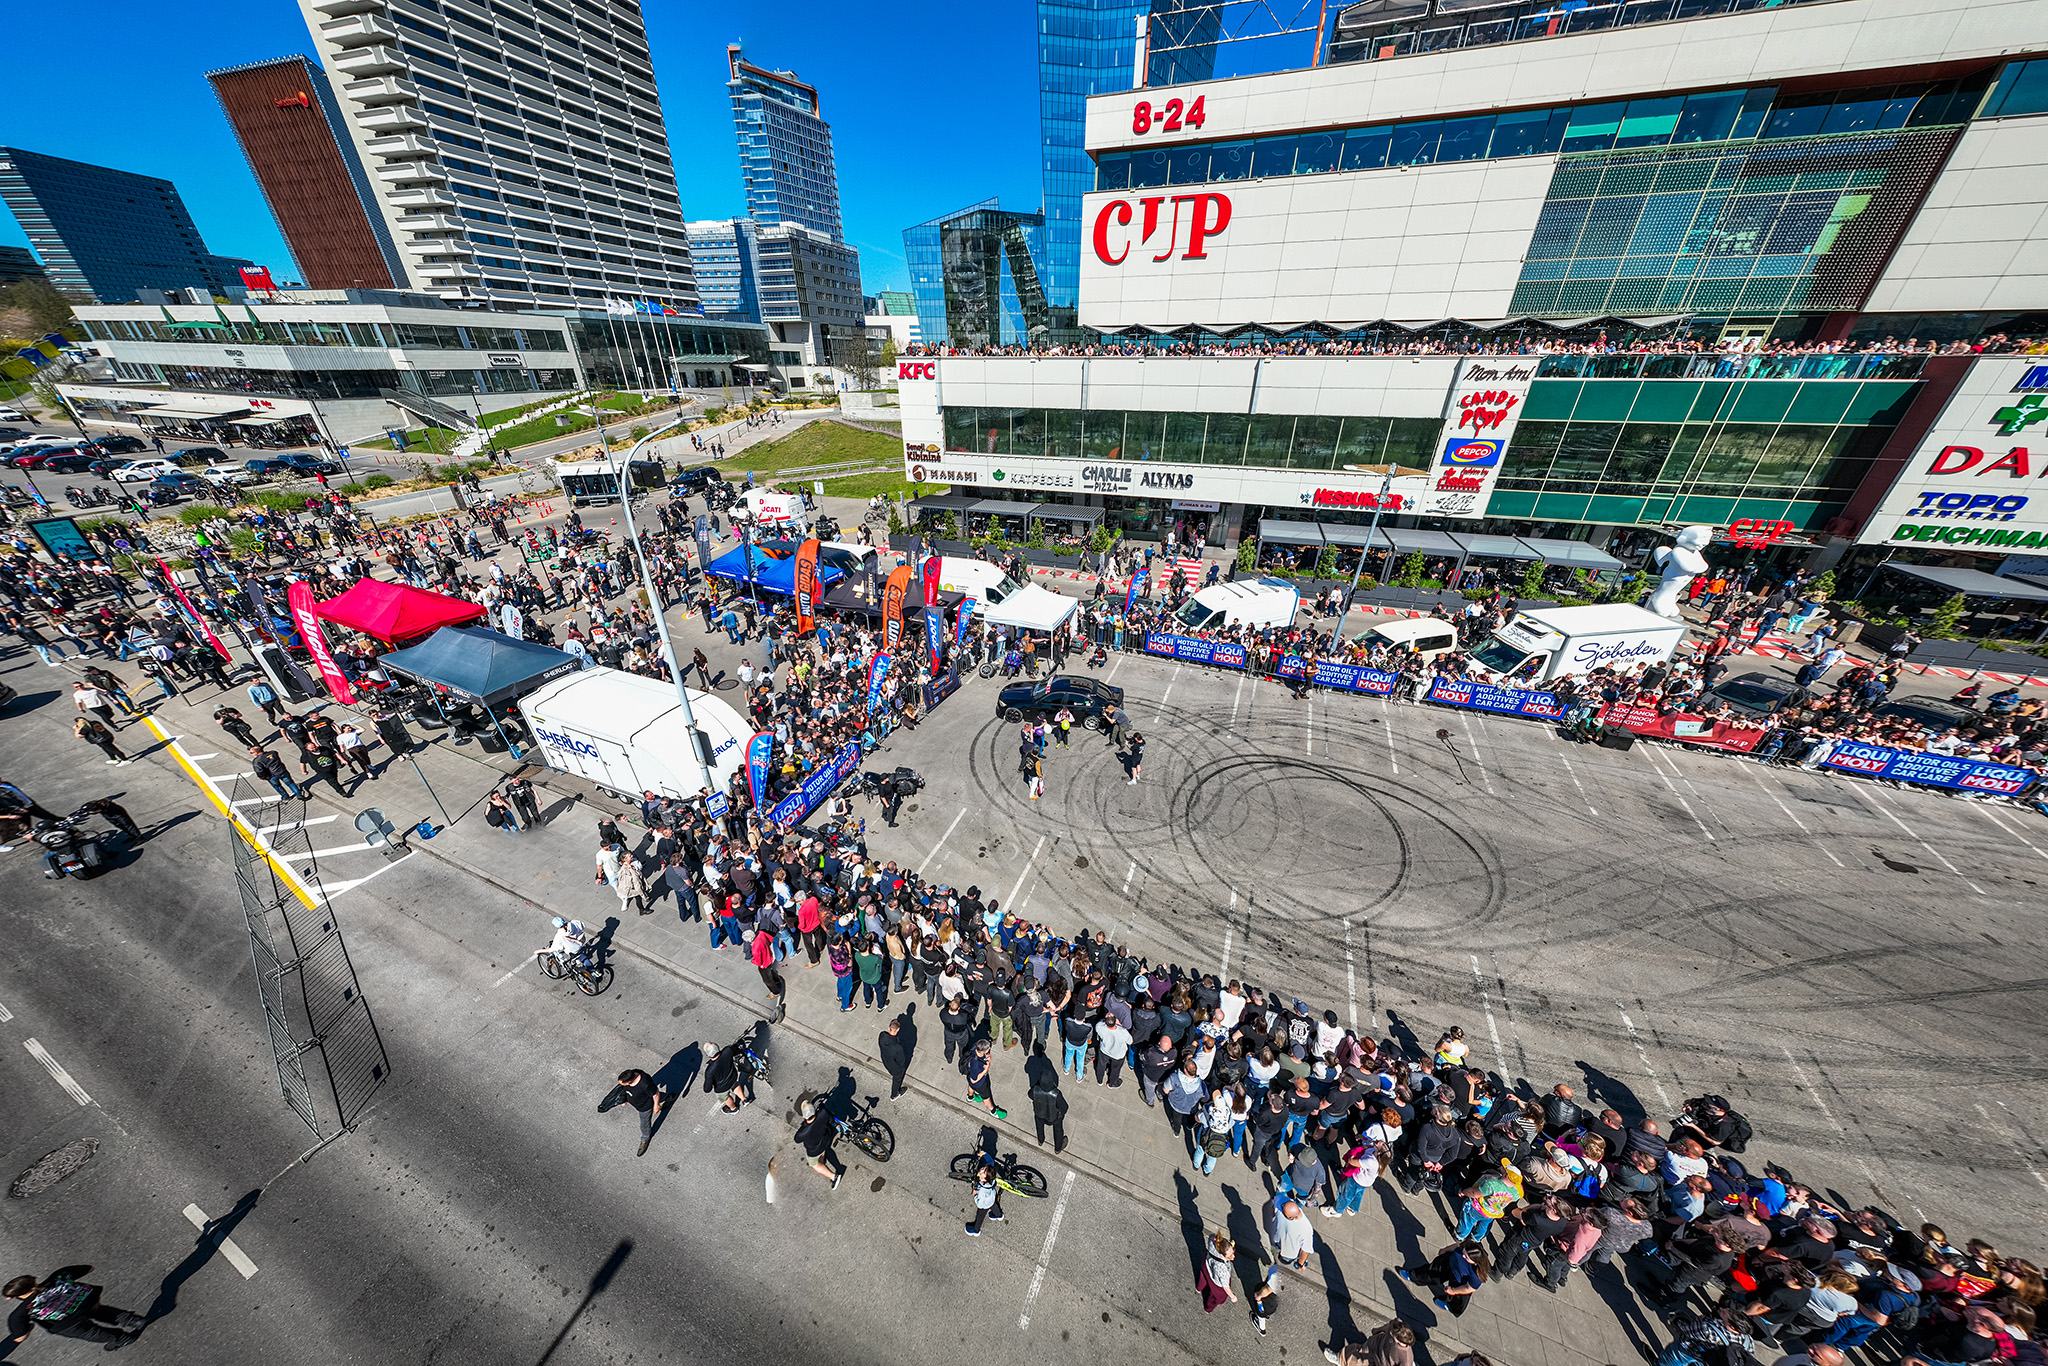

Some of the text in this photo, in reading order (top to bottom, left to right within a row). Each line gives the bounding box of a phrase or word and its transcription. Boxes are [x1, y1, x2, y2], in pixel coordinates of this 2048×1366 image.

[1133, 95, 1206, 136] 8-24
[1093, 192, 1232, 266] CUP
[898, 362, 935, 380] KFC
[1463, 364, 1499, 382] Mon
[1460, 390, 1519, 410] CANDY
[1458, 447, 1490, 457] PEPCO
[1925, 445, 2048, 478] DA
[930, 469, 977, 482] MANAMI
[1082, 466, 1132, 483] CHARLIE
[1140, 472, 1193, 489] ALYNAS
[1094, 482, 1119, 493] PIZZA
[1312, 488, 1403, 512] HESBURGER
[1918, 492, 2029, 513] TOPO
[1728, 518, 1795, 540] CUP
[800, 559, 813, 616] GIDAS AUTO
[888, 585, 902, 619] GIDAS
[296, 608, 342, 678] DUCATI
[1148, 642, 1175, 654] MOLY
[1150, 634, 1174, 646] LIQUI
[1177, 639, 1214, 650] MOTOR OILS
[1178, 645, 1210, 655] ADDITIVES
[1192, 651, 1209, 660] CARE
[1216, 644, 1244, 657] LIQUI
[1574, 640, 1662, 670] Sjöboden
[1213, 653, 1243, 665] MOLY
[1283, 658, 1306, 669] LIQU
[543, 663, 573, 679] SHERLOG
[1342, 667, 1358, 676] OILS
[1361, 671, 1392, 683] LIQUI
[1316, 675, 1351, 686] CAR CARE
[1359, 681, 1390, 691] MOLY
[1438, 681, 1472, 693] LIQUI
[1435, 689, 1468, 701] MOLY
[1476, 693, 1520, 704] ADDITIVES
[1493, 701, 1516, 710] CARE
[536, 727, 598, 758] SHERLOG
[712, 736, 738, 758] ERLOG
[1840, 744, 1894, 762] LIQUI
[838, 751, 858, 776] MOLY
[1831, 754, 1884, 771] MOLY
[1895, 762, 1961, 776] ADDITIVES
[1898, 754, 1971, 770] MOTOR OILS
[1891, 768, 1952, 783] CAR CARE
[1962, 776, 2019, 792] MOLY
[774, 794, 804, 823] LIQUI
